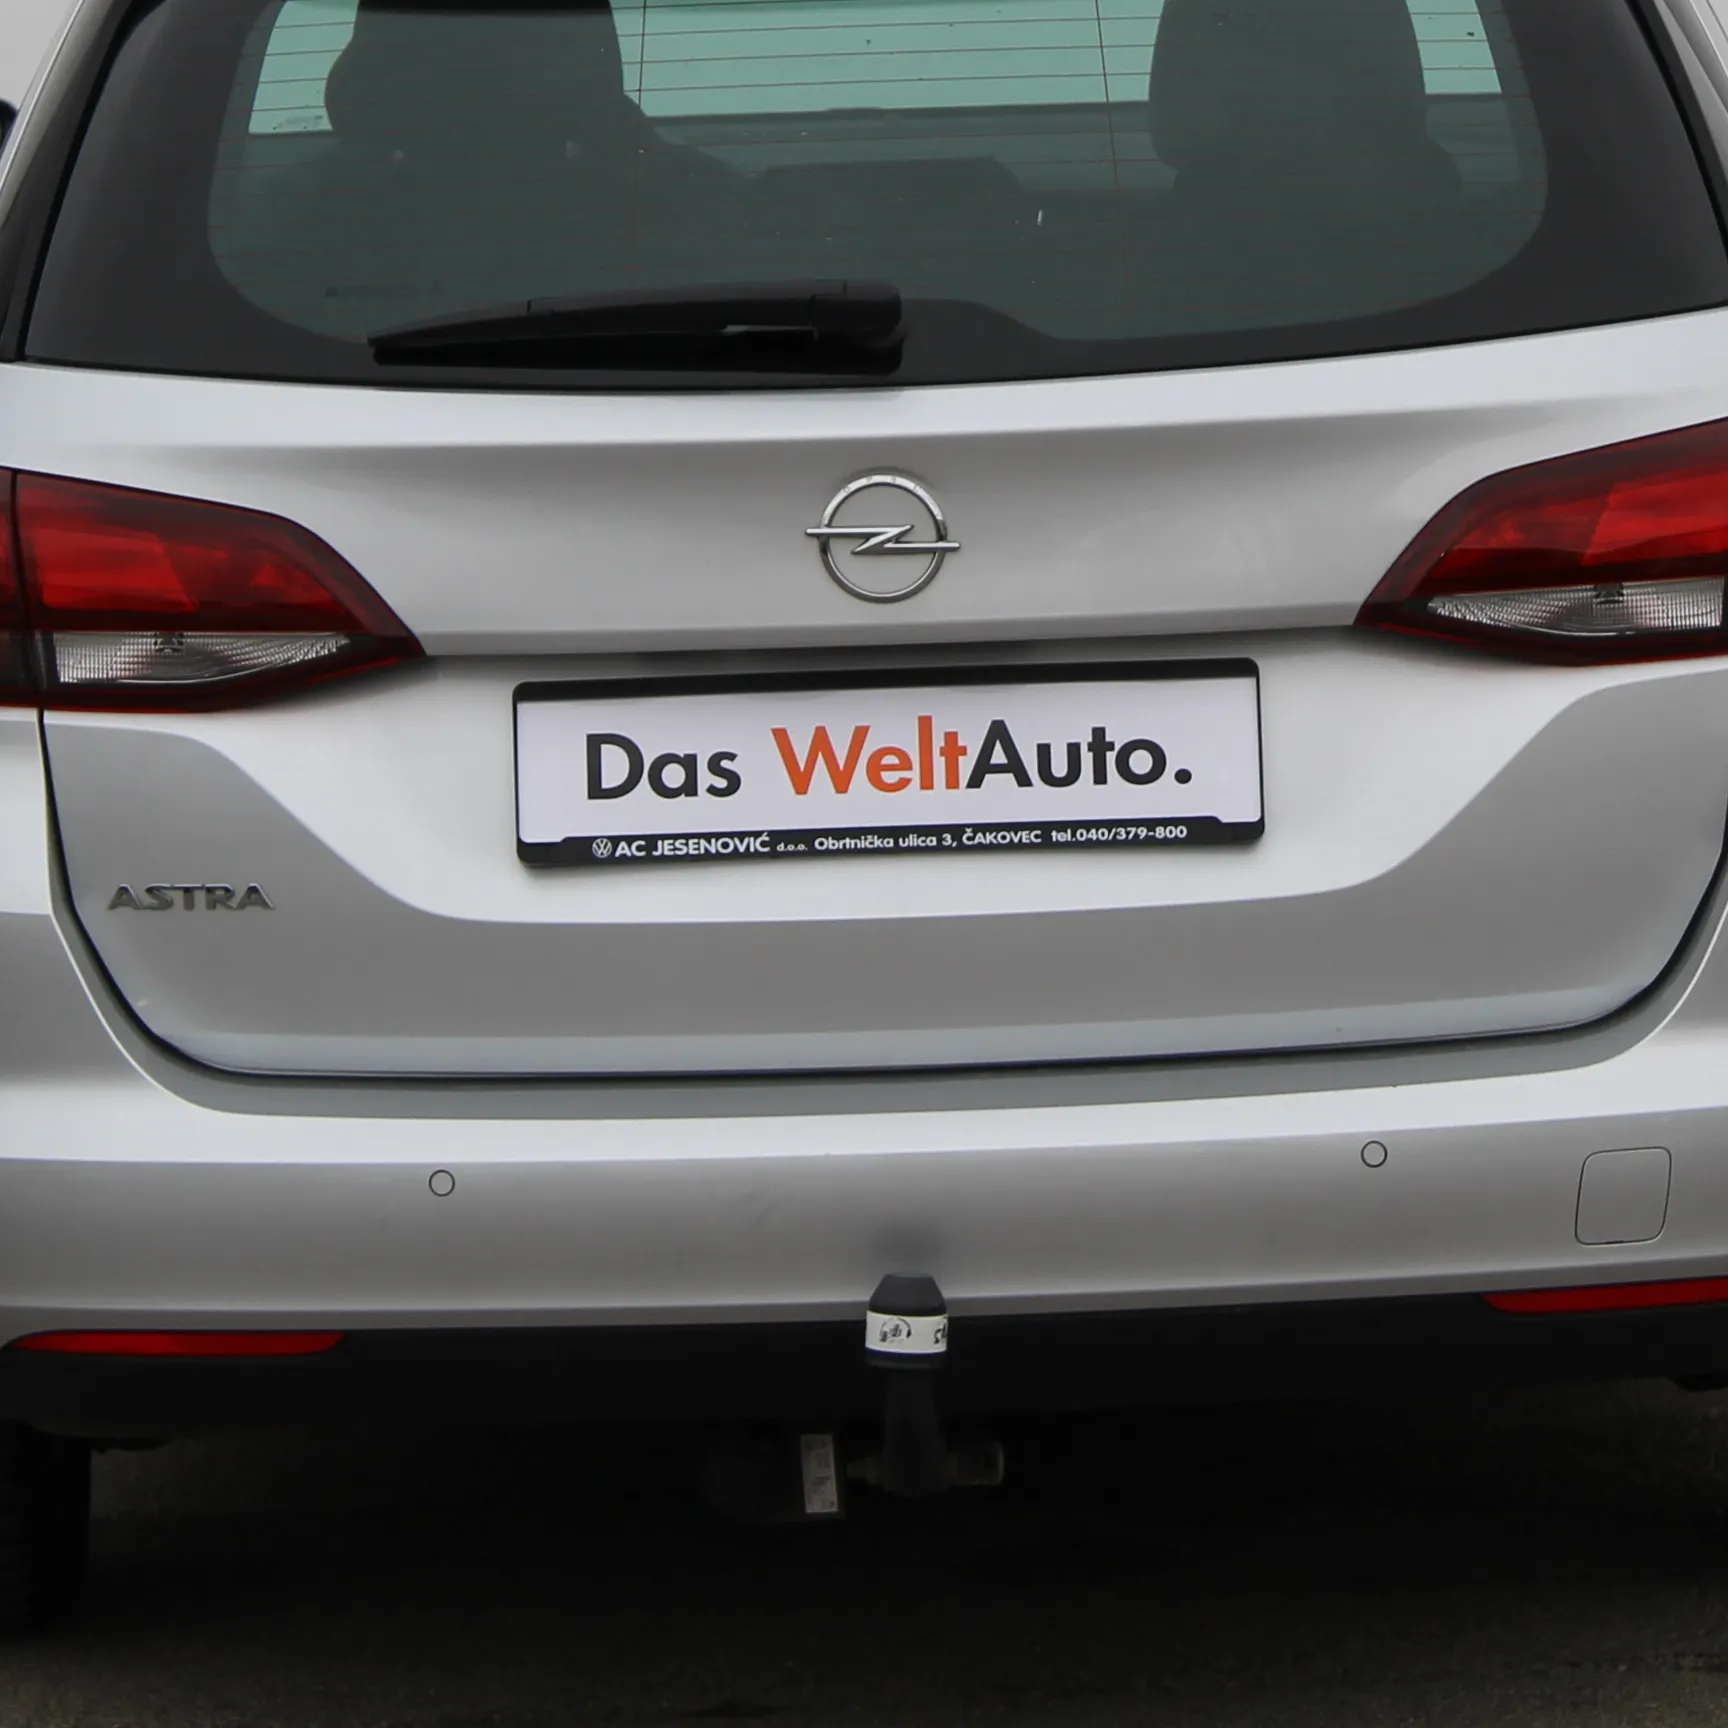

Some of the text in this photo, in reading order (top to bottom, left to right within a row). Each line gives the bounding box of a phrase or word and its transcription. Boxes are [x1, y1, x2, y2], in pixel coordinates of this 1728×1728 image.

[584, 714, 1194, 802] Das WeltAuto.
[614, 839, 647, 858] AC
[651, 831, 771, 857] JESENOVIĆ
[775, 842, 809, 853] d.o.o.
[813, 834, 895, 851] Obrtnička
[898, 833, 938, 849] ulica
[940, 833, 959, 848] 3,
[961, 827, 1043, 846] ČAKOVEC
[1050, 824, 1189, 843] tel.040/379-800
[107, 882, 276, 911] ASTRA
